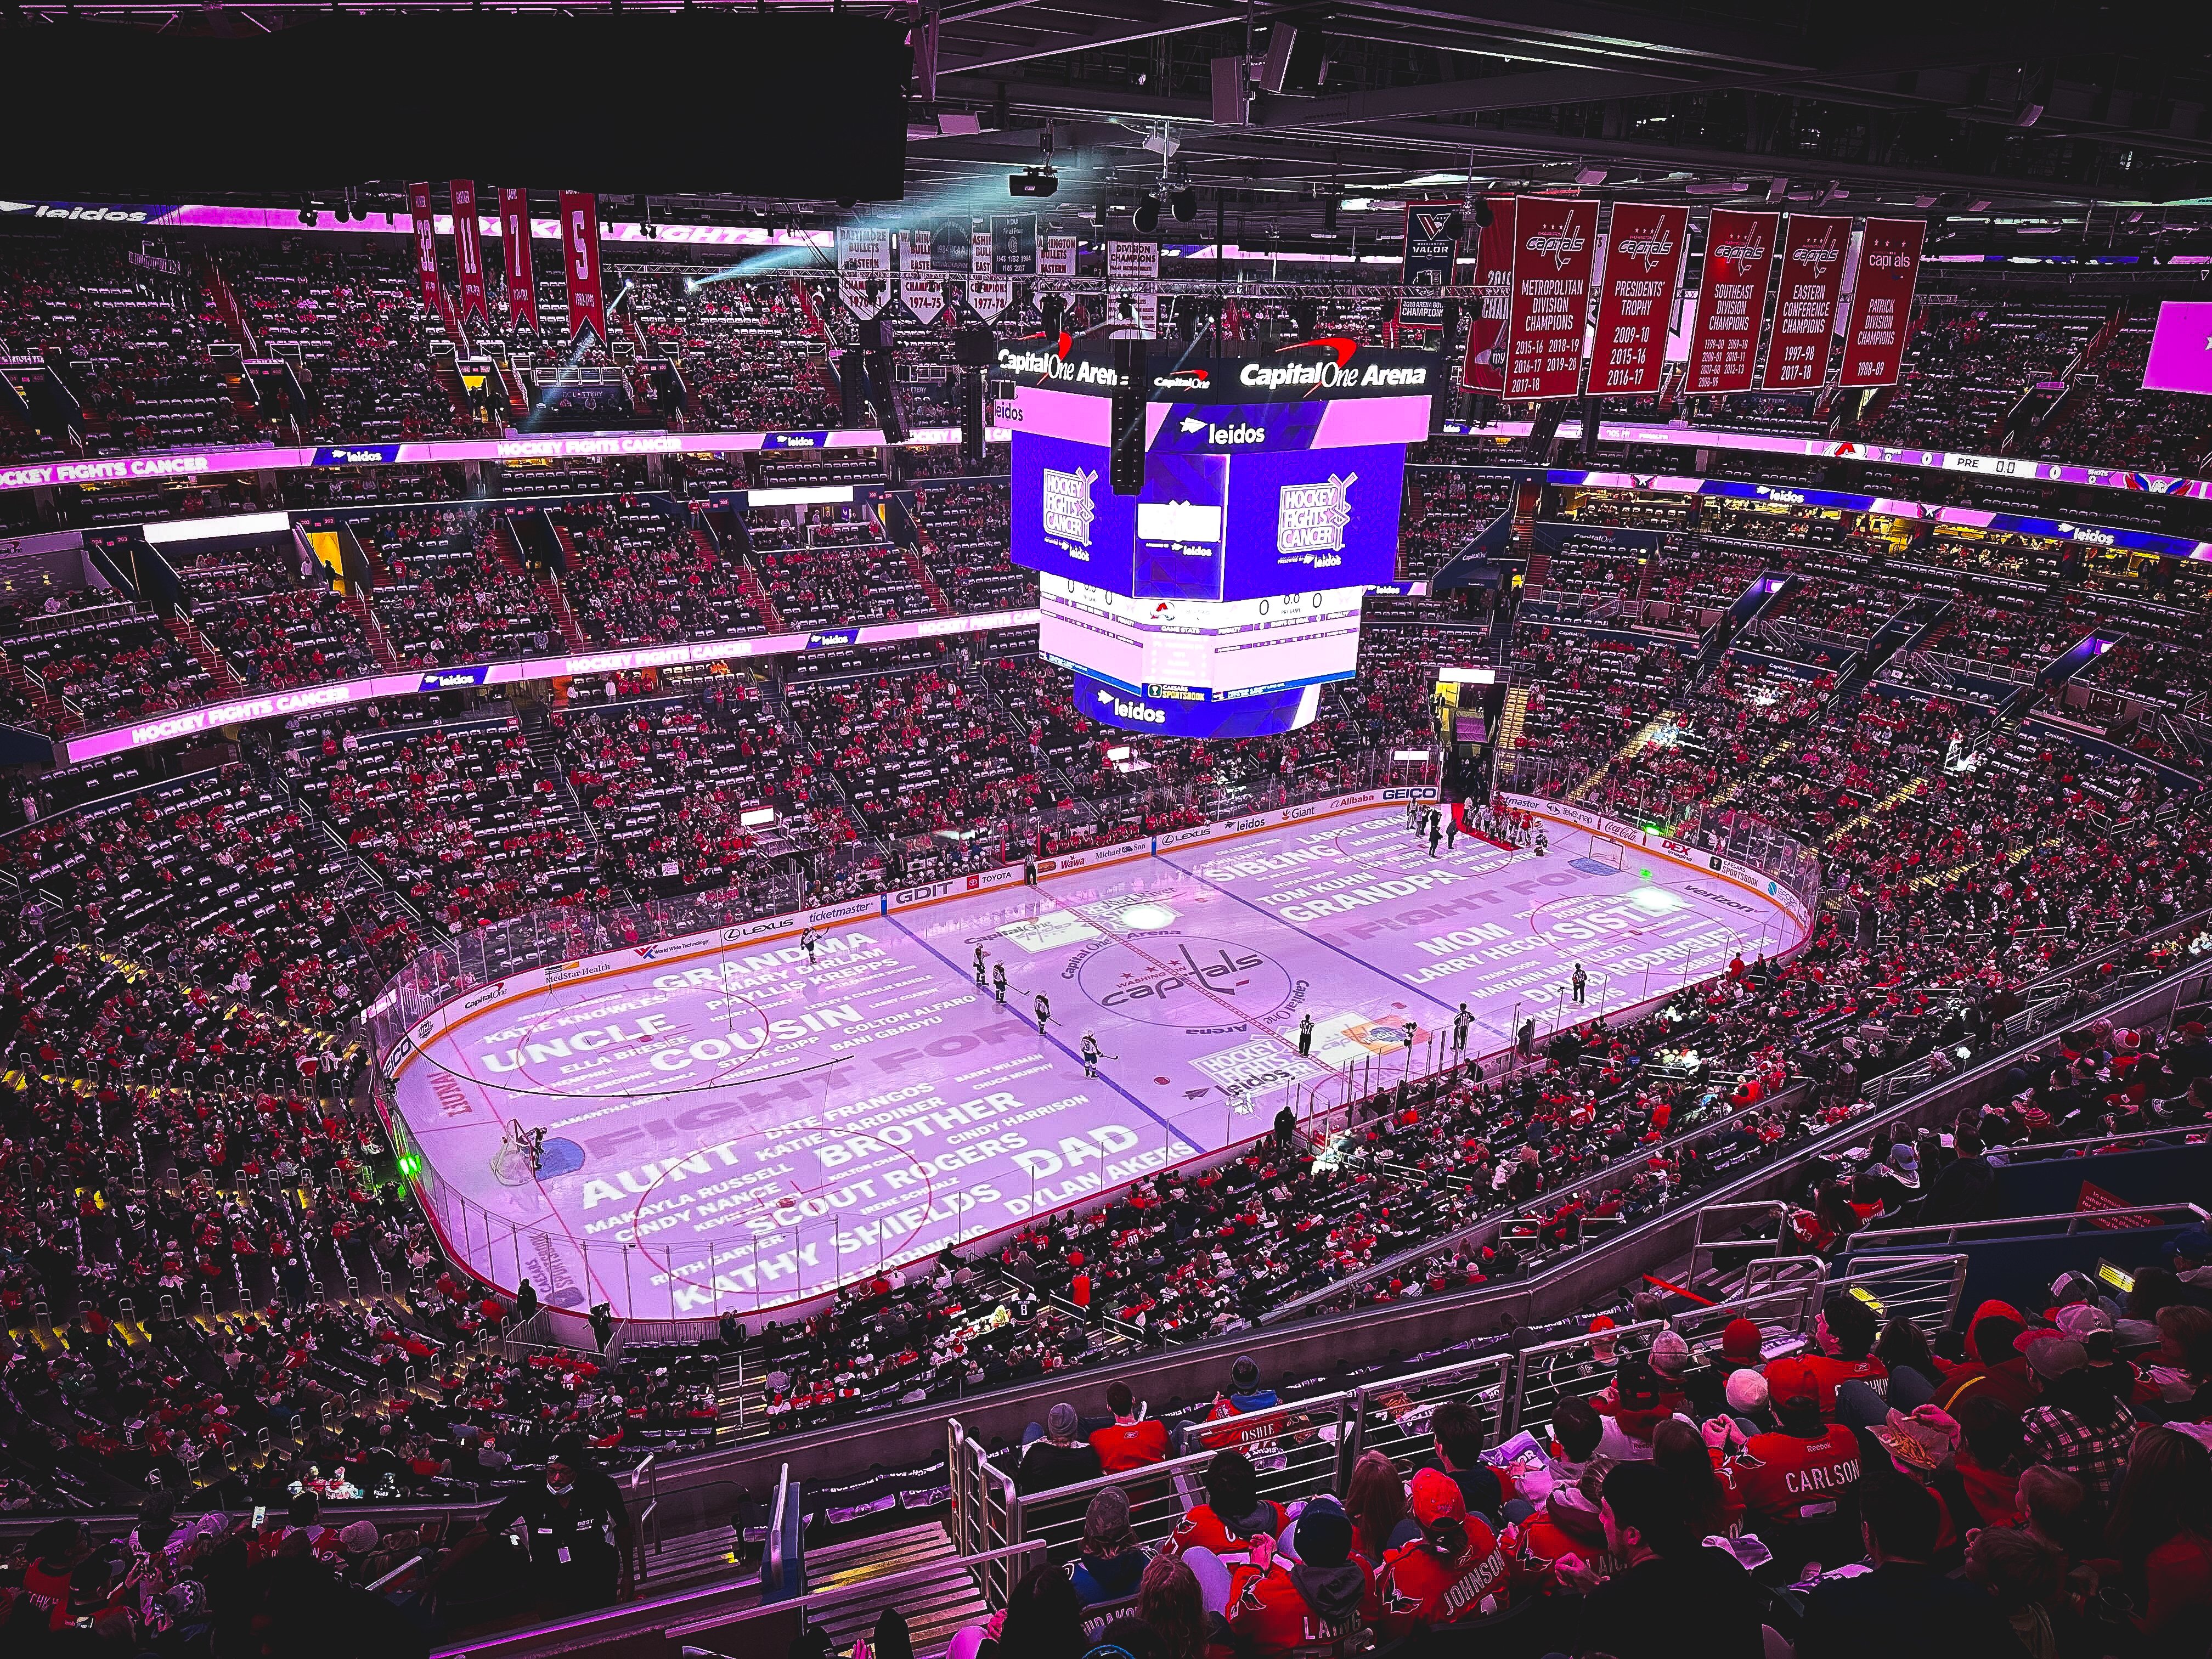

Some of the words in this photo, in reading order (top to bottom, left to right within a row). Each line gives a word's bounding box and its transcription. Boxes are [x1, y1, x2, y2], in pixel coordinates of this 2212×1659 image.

[35, 205, 147, 221] leidos
[461, 218, 476, 273] 11
[572, 211, 588, 279] 5
[1116, 245, 1150, 253] DIVISION
[1110, 253, 1156, 263] CHAMPIONS
[1521, 279, 1583, 295] METROPOLITAN
[1714, 284, 1754, 300] SOUTHEAST
[1793, 285, 1825, 300] EASTERN
[909, 297, 941, 308] 1974-75
[974, 298, 1005, 309] 1977-78
[1532, 297, 1568, 313] DIVISION
[1621, 300, 1652, 316] TROPHY
[1716, 301, 1746, 315] DIVISION
[1783, 302, 1830, 317] CONFERENCE
[1868, 299, 1895, 313] PATRICK
[1526, 315, 1573, 331] CHAMPIONS
[1709, 315, 1749, 331] CHAMPIONS
[1782, 319, 1825, 334] CHAMPIONS
[1865, 315, 1893, 329] DIVISION
[1615, 326, 1650, 343] 2009-10
[1857, 331, 1895, 345] CHAMPIONS
[1516, 341, 1543, 355] 2015-16
[1549, 338, 1579, 353] 2018-19
[1610, 348, 1646, 365] 2015-16
[1785, 346, 1815, 361] 1997-98
[1361, 365, 1426, 386] Arena
[1514, 359, 1542, 374] 2016-17
[1547, 357, 1577, 371] 2019-20
[1781, 365, 1811, 380] 2017-18
[1857, 361, 1884, 376] 1988-89
[1511, 379, 1540, 393] 2017-18
[1607, 369, 1644, 386] 2016-17
[1209, 422, 1265, 444] leidos
[57, 463, 128, 480] FIGHTS
[131, 457, 208, 473] CANCER
[347, 451, 382, 462] leidos
[498, 442, 563, 456] HOCKEY
[566, 437, 620, 454] FIGHTS
[1921, 452, 1932, 465] 0
[1956, 458, 1979, 469] PRE
[2050, 466, 2062, 479] 0
[1047, 474, 1082, 498] HOCKEY
[1047, 494, 1081, 516] FIGHTS
[1285, 488, 1336, 509] HOCKEY
[1046, 511, 1082, 537] CANCER
[1282, 509, 1330, 528] FIGHTS
[1770, 487, 1805, 503] leidos
[2073, 528, 2115, 545] leidos
[1282, 527, 1333, 547] CANCER
[1183, 546, 1212, 556] leidos
[1314, 553, 1342, 568] leidos
[1259, 599, 1269, 615] 0
[1312, 592, 1322, 608] 0
[132, 715, 204, 744] HOCKEY
[209, 701, 273, 725] FIGHTS
[276, 686, 351, 712] CANCER
[439, 674, 475, 686] leidos
[566, 654, 633, 673] HOCKEY
[635, 647, 690, 664] FIGHTS
[692, 642, 753, 658] CANCER
[1114, 698, 1166, 724] leidos
[1339, 793, 1374, 806] Alibaba
[1383, 788, 1437, 799] GEICO
[1291, 806, 1316, 819] Giant
[1175, 828, 1211, 842] LEXUS
[1237, 818, 1265, 832] leidos
[1295, 823, 1362, 846] LARRY
[1095, 846, 1121, 860] Michael
[1133, 843, 1146, 851] Son
[1662, 840, 1691, 856] DEX
[1206, 845, 1343, 882] SIBLING
[1723, 860, 1746, 872] CAESARS
[981, 871, 1012, 883] TOYOTA
[1722, 866, 1758, 887] SPORTSBOOK
[896, 882, 953, 904] GDIT
[1256, 884, 1314, 907] TOM
[1310, 872, 1379, 895] KUHN
[1278, 868, 1470, 923] GRANDPA
[1684, 885, 1755, 913] verizon
[809, 903, 871, 923] ticketmaster
[743, 918, 794, 936] LEXUS
[1414, 922, 1515, 957] MOM
[652, 932, 879, 991] GRANDMA
[1402, 951, 1485, 985] LARRY
[1481, 929, 1566, 961] HECOX
[546, 970, 582, 984] MedStar
[582, 963, 611, 977] Health
[716, 968, 790, 994] MARY
[794, 947, 887, 975] DIRLAM
[1102, 944, 1264, 1006] capitals
[704, 980, 807, 1011] PHYLLIS
[808, 957, 900, 985] KREPPS
[1469, 973, 1543, 1000] MARYANN
[483, 1022, 554, 1045] KATIE
[557, 995, 669, 1027] KNOWLES
[843, 1011, 913, 1035] COLTON
[913, 995, 977, 1017] ALFARO
[481, 1013, 676, 1073] UNCLE
[650, 1003, 865, 1071] COUSIN
[830, 1036, 875, 1052] BANI
[874, 1015, 944, 1040] GBADYU
[558, 1055, 612, 1075] ELLA
[613, 1035, 692, 1061] BRESEE
[716, 1049, 774, 1069] STEVE
[774, 1036, 820, 1054] CUPP
[1203, 1040, 1281, 1071] HOCKEY
[953, 1068, 991, 1085] BARRY
[971, 1074, 1009, 1091] CHUCK
[1008, 1062, 1054, 1082] MURPHY
[764, 1114, 822, 1141] DITE
[823, 1081, 936, 1122] FRANGOS
[945, 1121, 1001, 1146] CINDY
[1000, 1094, 1091, 1128] HARRISON
[754, 1133, 827, 1163] KATIE
[827, 1096, 949, 1139] GARDINER
[812, 1091, 1026, 1169] BROTHER
[1011, 1124, 1139, 1182] DAD
[581, 1141, 744, 1210] AUNT
[743, 1178, 878, 1235] SCOUT
[882, 1130, 1029, 1190] ROGERS
[1002, 1171, 1110, 1217] DYLAN
[1099, 1139, 1197, 1182] AKERS
[584, 1197, 696, 1235] MAKAYLA
[697, 1163, 795, 1199] RUSSELL
[860, 1197, 899, 1215] IRENE
[614, 1208, 693, 1243] CINDY
[695, 1180, 782, 1216] NANCE
[673, 1243, 825, 1313] KATHY
[827, 1183, 1003, 1256] SHIELDS
[650, 1260, 708, 1286] RUTH
[710, 1235, 788, 1264] GARVER
[1242, 1423, 1275, 1442] OSHIE
[1808, 1442, 1832, 1453] Reebok
[1786, 1459, 1860, 1493] CARLSON
[1444, 1547, 1505, 1616] JOHNSON
